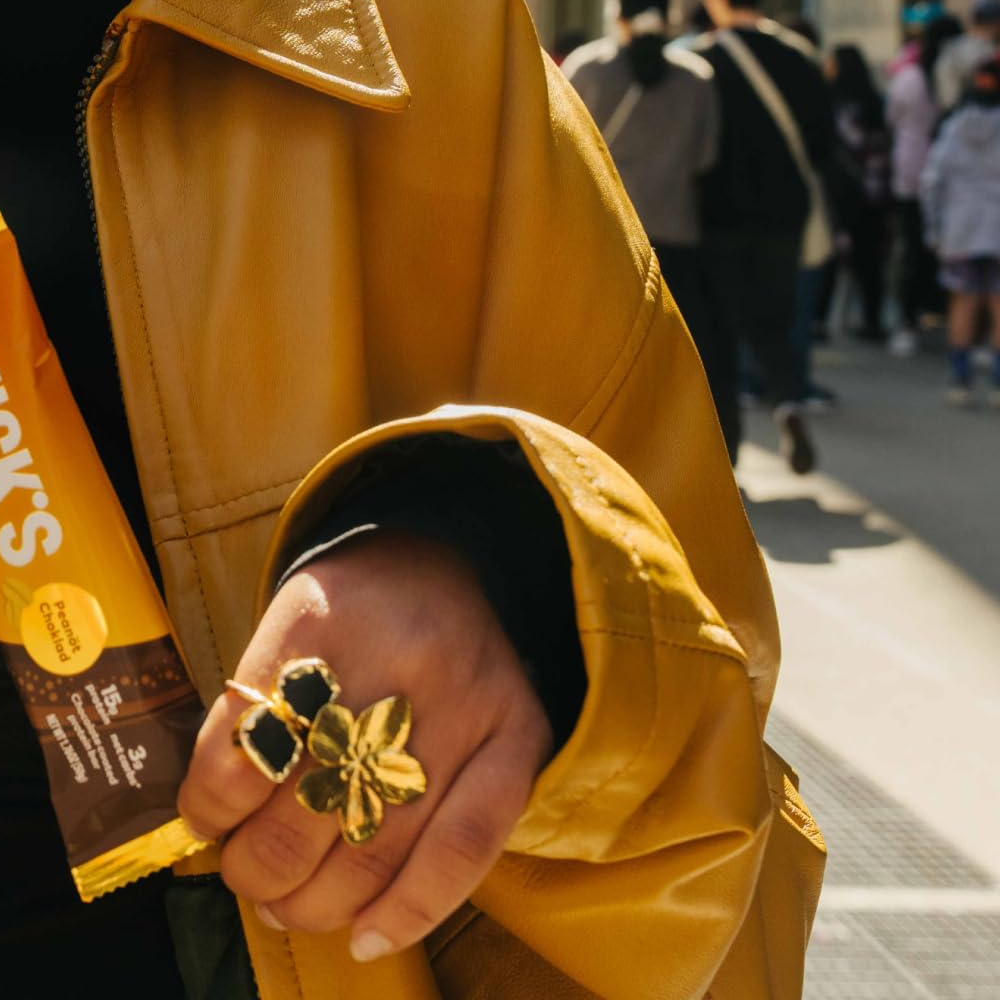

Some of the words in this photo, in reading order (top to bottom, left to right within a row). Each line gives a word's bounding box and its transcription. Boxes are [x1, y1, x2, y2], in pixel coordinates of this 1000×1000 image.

[40, 602, 71, 662] Choklad
[84, 683, 111, 726] protein
[66, 713, 92, 751] protein
[87, 748, 101, 769] bar
[71, 692, 101, 746] Chocolate
[97, 745, 120, 786] coated
[110, 733, 125, 755] net
[127, 744, 147, 771] 3g
